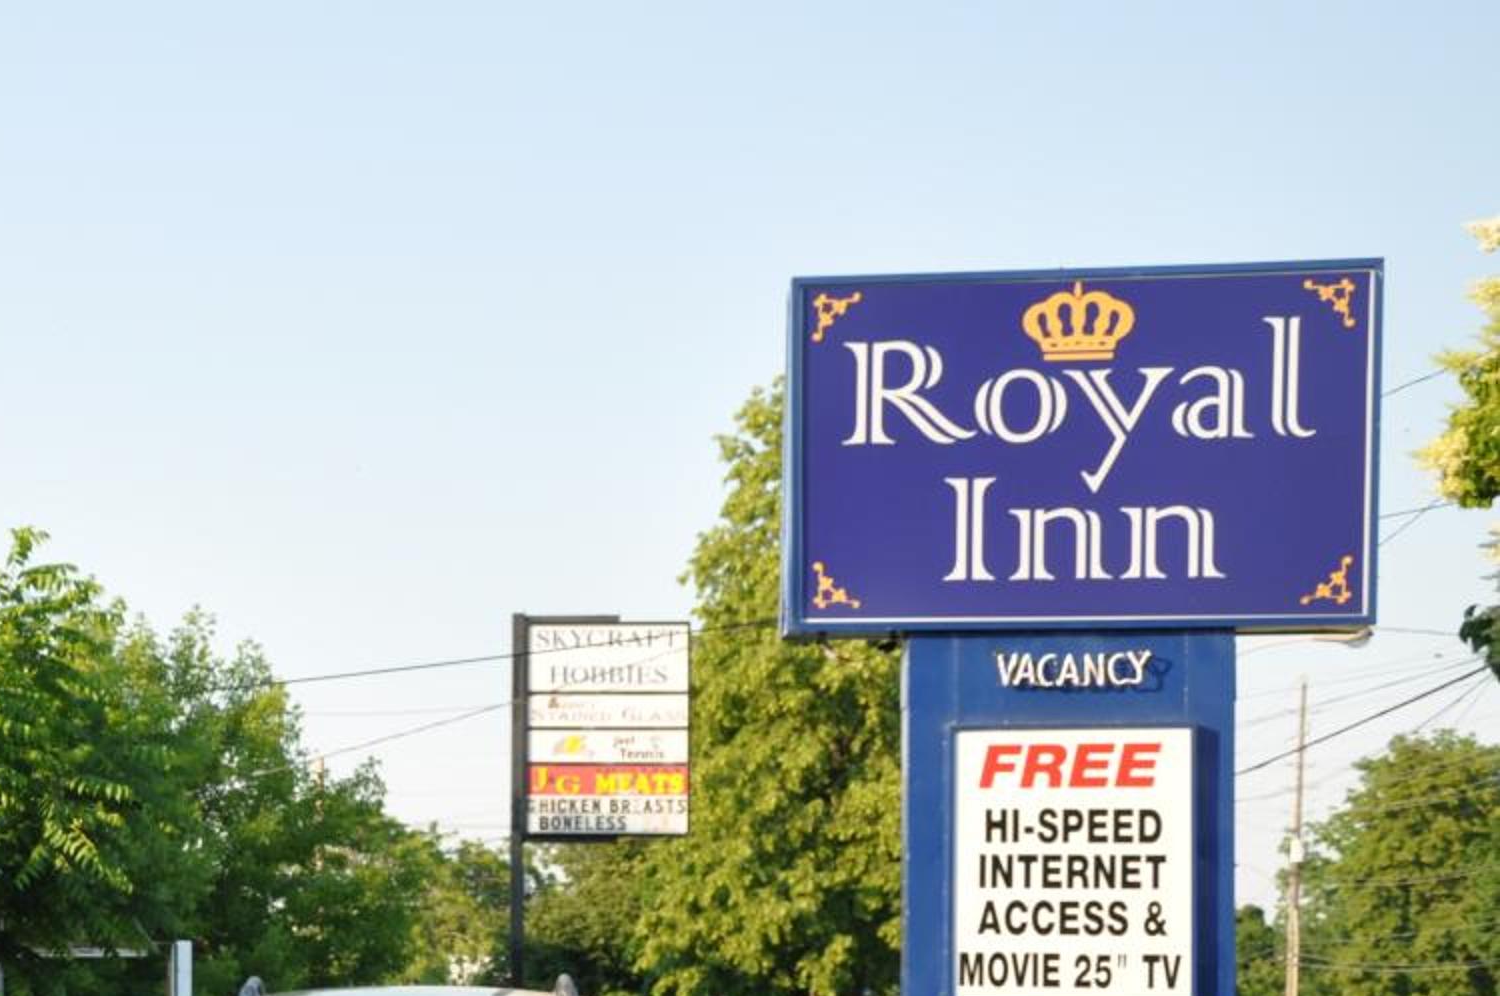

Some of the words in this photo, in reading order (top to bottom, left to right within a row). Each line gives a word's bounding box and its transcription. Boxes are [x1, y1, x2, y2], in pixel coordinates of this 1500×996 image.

[841, 315, 1317, 494] Royal
[942, 475, 1227, 582] Inn
[536, 628, 682, 649] SKYCRAFT
[550, 664, 669, 685] HOBBIES
[997, 650, 1152, 688] VACANCY
[979, 743, 1162, 790] FREE
[539, 816, 628, 831] BONELESS
[985, 808, 1163, 844] HI-SPEED
[979, 854, 1167, 889] INTERNET
[978, 900, 1129, 936] ACCESS
[1144, 900, 1167, 936] &
[959, 952, 1060, 988] MOVIE
[1074, 954, 1127, 989] 25"
[1142, 954, 1182, 990] TV
